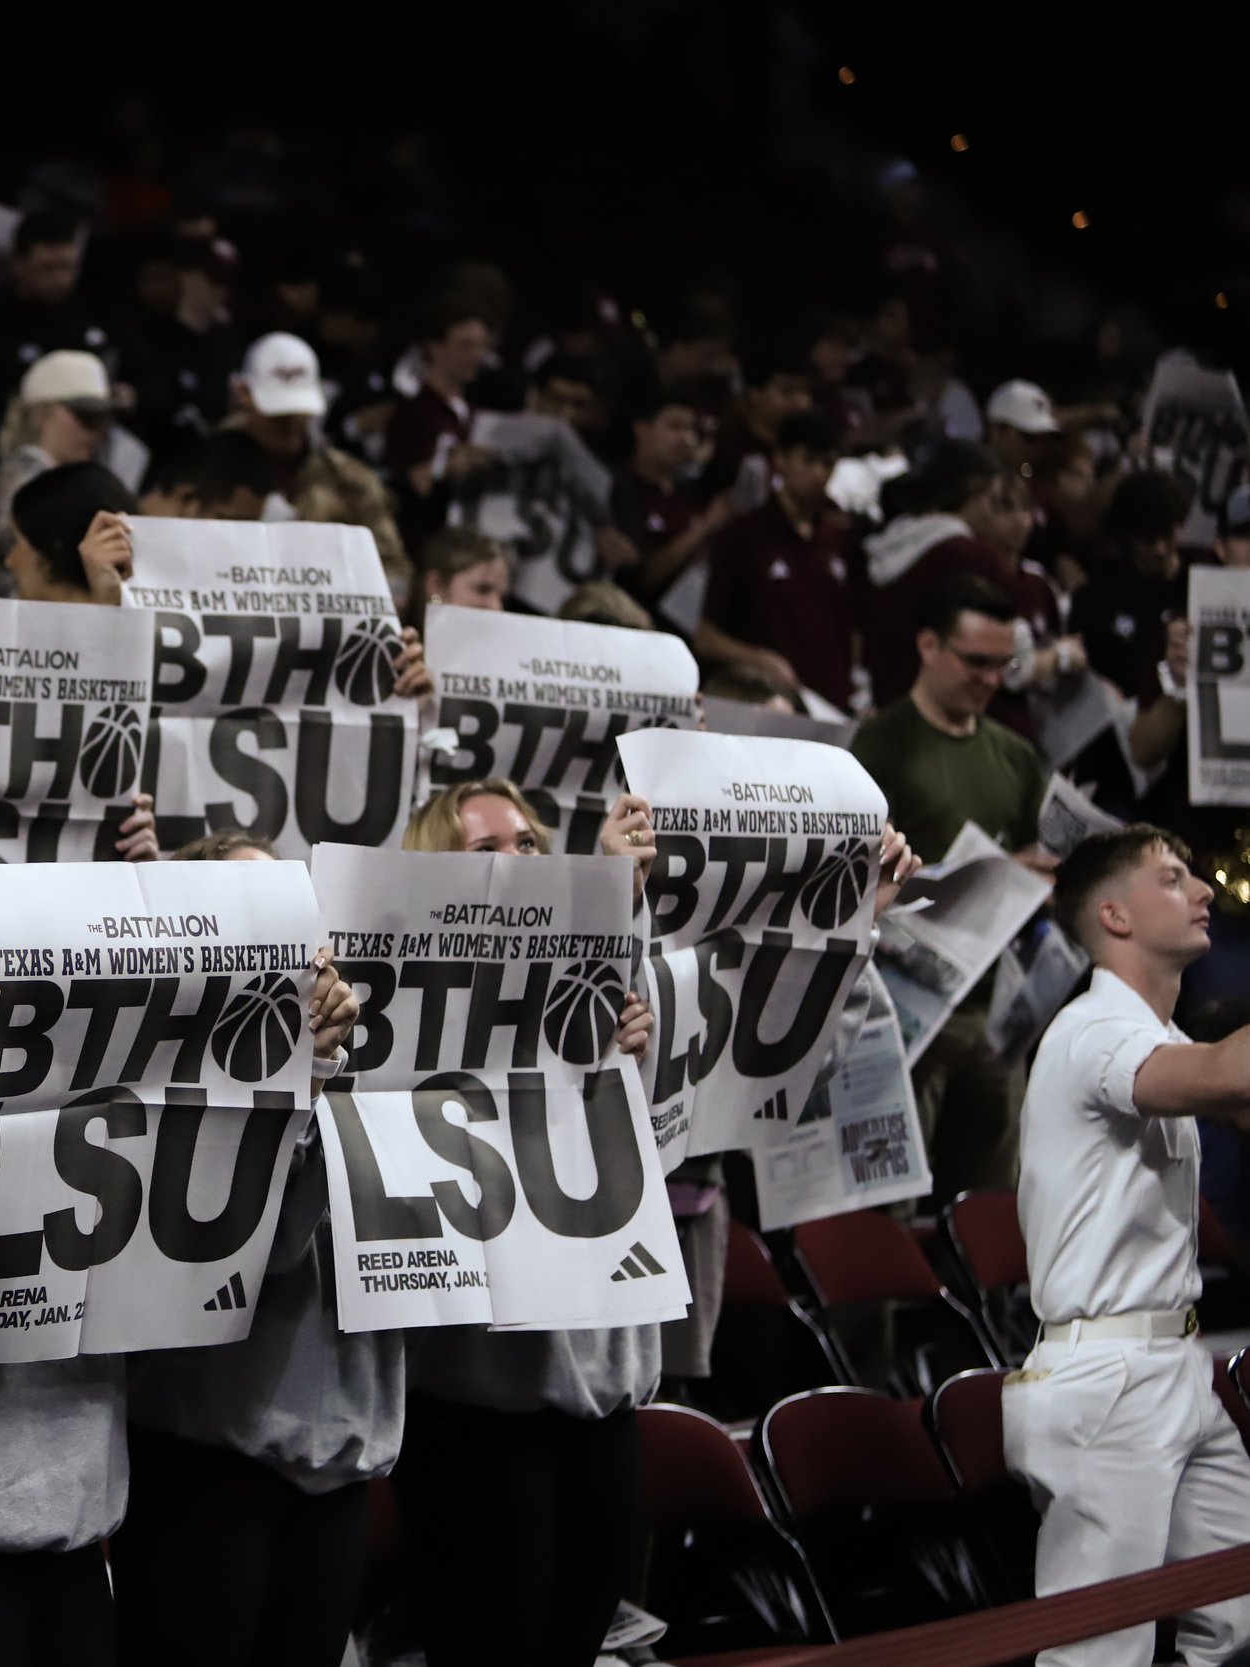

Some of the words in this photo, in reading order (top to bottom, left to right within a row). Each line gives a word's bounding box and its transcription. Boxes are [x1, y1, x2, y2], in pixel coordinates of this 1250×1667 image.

[231, 566, 332, 586] BATTALION
[128, 586, 184, 609] TEXAS
[190, 590, 226, 612] A&M
[231, 591, 311, 614] WOMEN'S
[531, 658, 622, 682] BATTALION
[57, 677, 147, 702] BASKETBALL
[441, 672, 491, 696] TEXAS
[498, 677, 528, 700] A&M
[533, 682, 600, 708] WOMEN'S
[606, 689, 692, 716] BASKETBALL
[732, 782, 814, 804] BATTALION
[651, 807, 697, 831] TEXAS
[702, 809, 731, 833] A&M
[736, 810, 798, 834] WOMEN'S
[802, 811, 882, 836] BASKETBALL
[87, 923, 102, 933] THE
[103, 915, 219, 940] BATTALION
[430, 911, 443, 920] THE
[442, 904, 552, 927] BATTALION
[328, 931, 394, 959] TEXAS
[397, 932, 434, 958] A&M
[438, 933, 523, 960] WOMEN'S
[526, 934, 632, 960] BASKETBALL
[61, 948, 102, 975] A&M
[107, 946, 195, 975] WOMEN'S
[200, 943, 312, 973] BASKETBALL
[652, 928, 858, 1104] LSU
[320, 1068, 646, 1242] LSU
[357, 1253, 404, 1271] REED
[406, 1250, 459, 1268] ARENA
[360, 1271, 452, 1293] THURSDAY,
[454, 1271, 484, 1289] JAN.
[34, 1305, 71, 1326] JAN.
